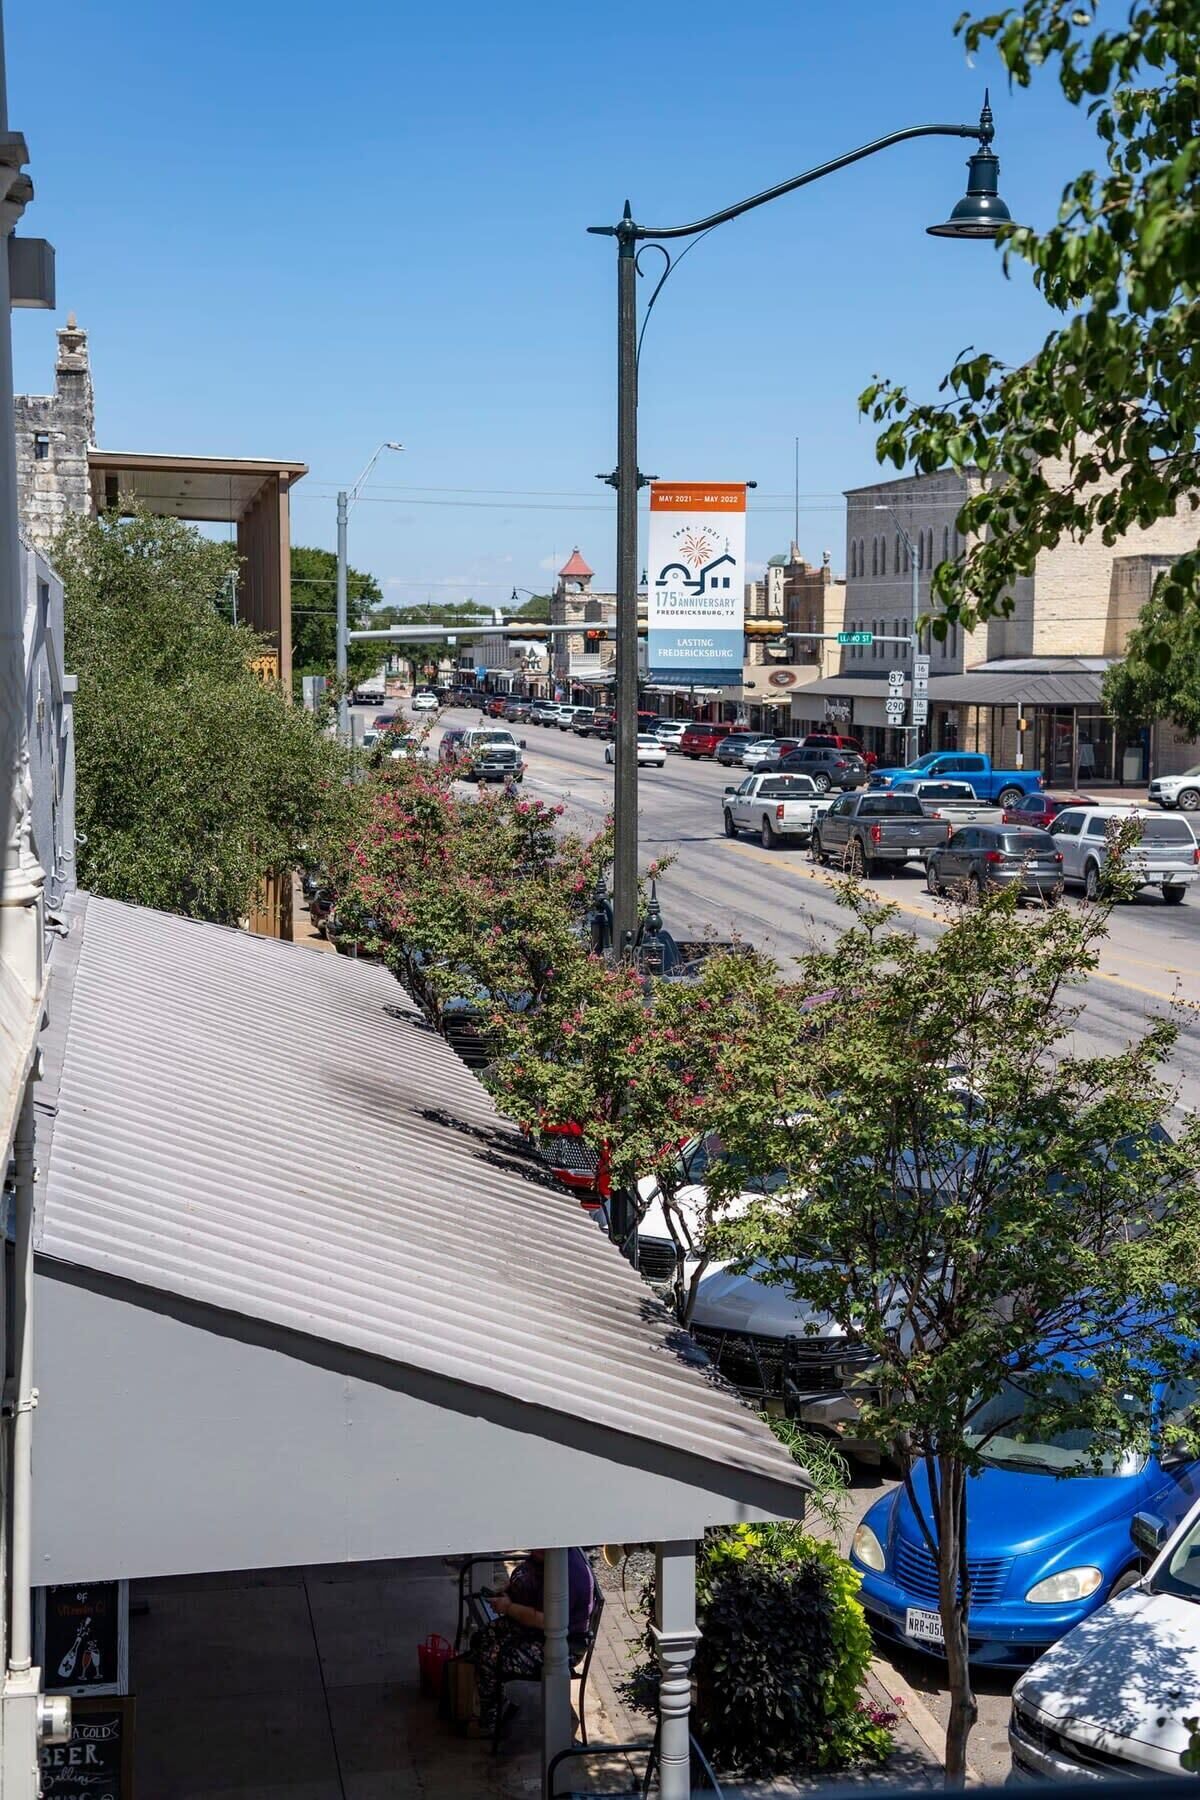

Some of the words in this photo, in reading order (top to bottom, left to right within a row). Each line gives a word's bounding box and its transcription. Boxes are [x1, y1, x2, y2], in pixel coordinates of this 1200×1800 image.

[658, 495, 673, 503] MAY
[675, 495, 692, 503] 2021
[704, 495, 718, 503] MAY
[702, 526, 720, 540] 2021
[678, 598, 736, 608] ANNIVERSARY
[677, 638, 714, 647] LASTING
[862, 634, 870, 642] ST
[658, 648, 733, 657] FREDERICKSBURG
[890, 673, 903, 683] 87
[887, 701, 904, 711] 290
[921, 1612, 940, 1621] TEXAS
[82, 1727, 111, 1738] COLD
